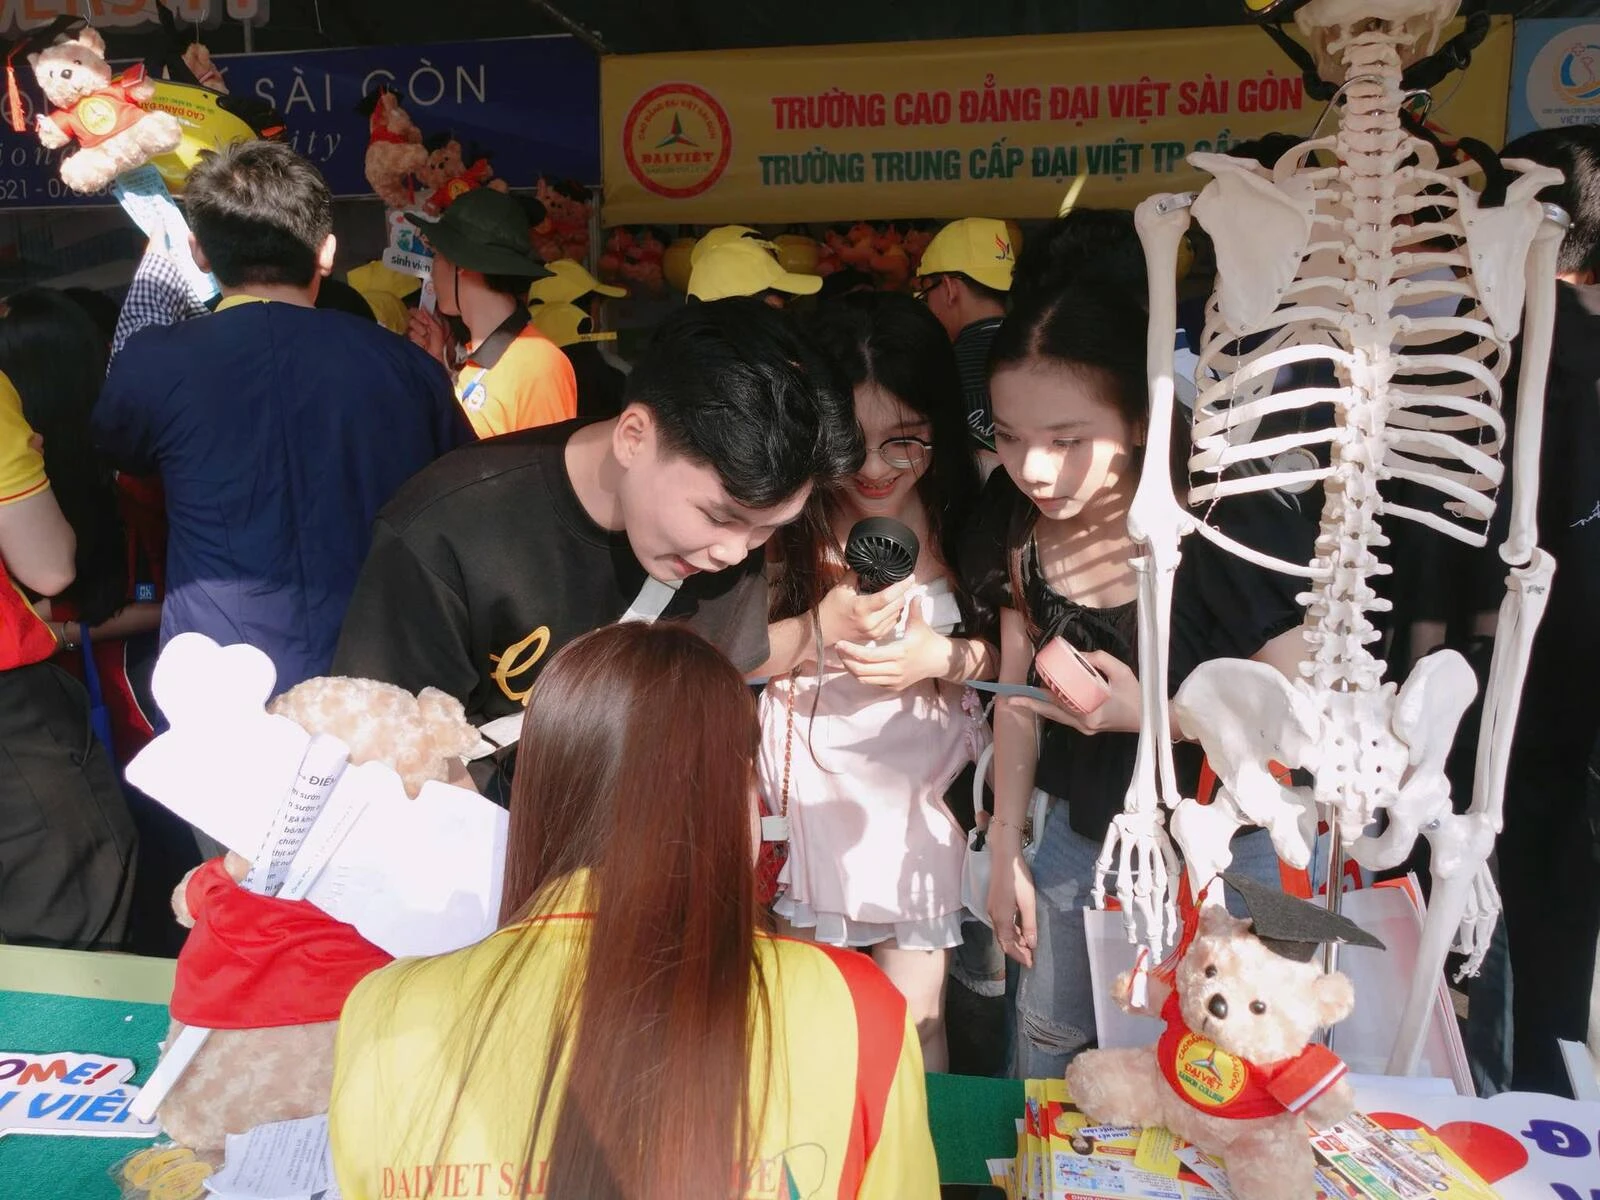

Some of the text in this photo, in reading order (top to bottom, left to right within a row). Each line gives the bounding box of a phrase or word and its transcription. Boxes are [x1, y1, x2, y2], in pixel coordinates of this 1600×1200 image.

[772, 69, 1303, 130] TRƯỜNG CAO ĐẲNG ĐẠI VIỆT SÀI GÒN
[759, 146, 865, 186] TRƯỜNG
[872, 150, 961, 183] TRUNG
[969, 137, 1024, 180] CẤP
[1032, 146, 1078, 184] ĐẠI
[1086, 137, 1144, 182] VIỆT
[1151, 141, 1186, 174] TP
[391, 254, 412, 269] sinh
